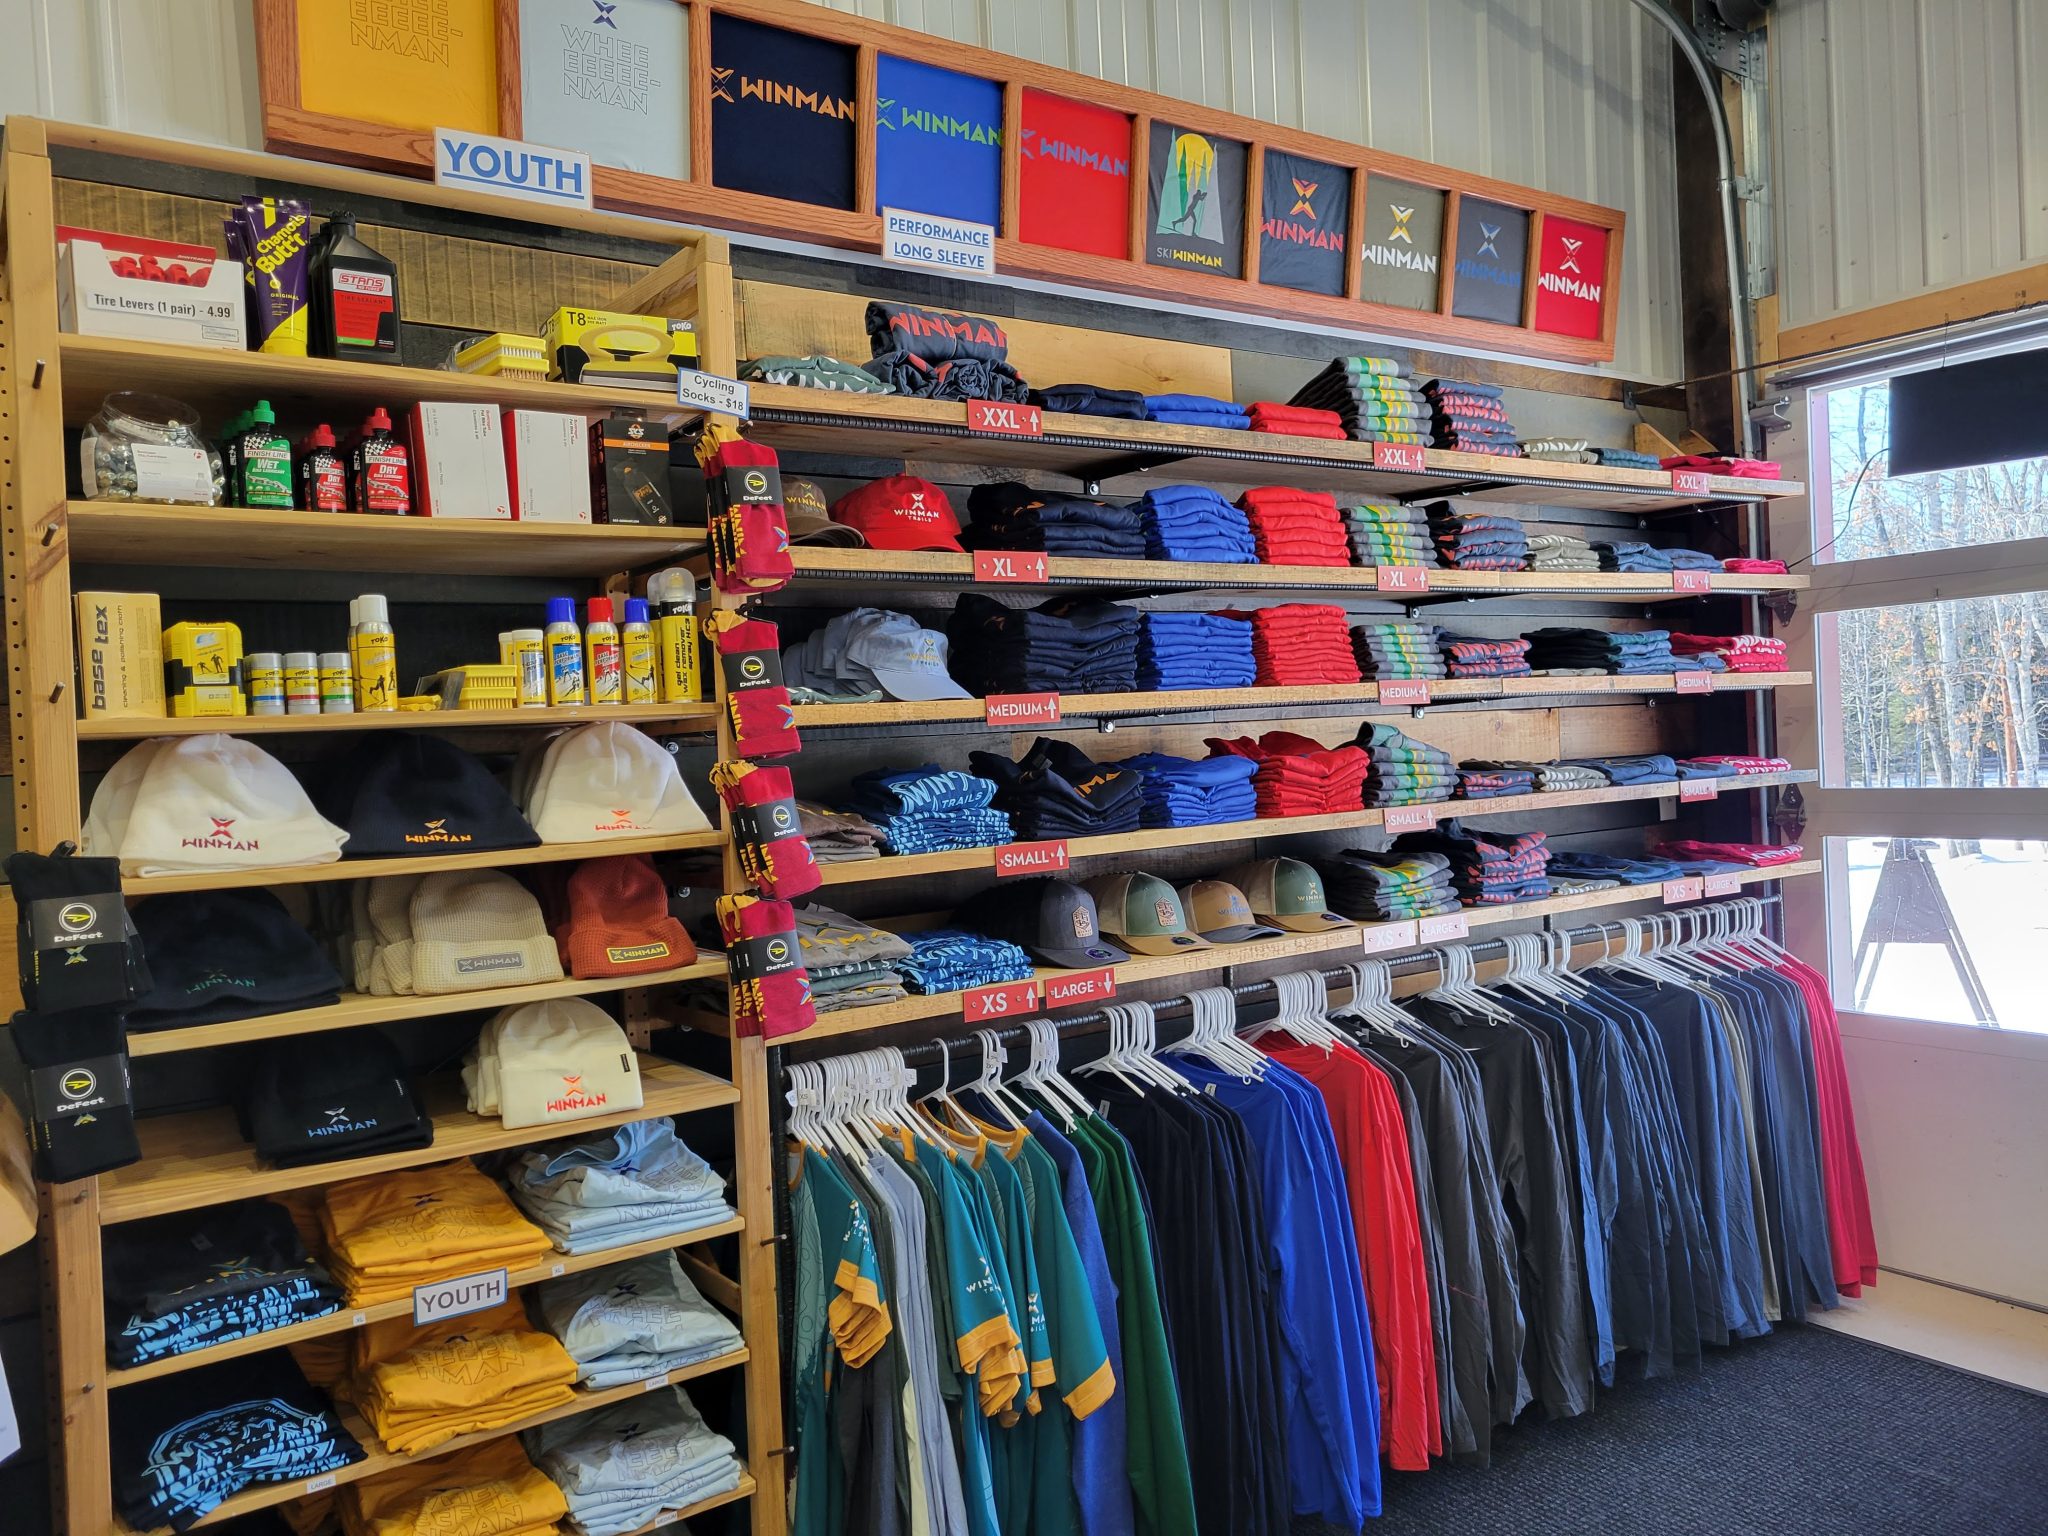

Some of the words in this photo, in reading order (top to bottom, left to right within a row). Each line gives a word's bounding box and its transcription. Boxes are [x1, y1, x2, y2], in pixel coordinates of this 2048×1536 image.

[350, 21, 449, 68] NMAN
[560, 24, 649, 68] WHEE
[563, 72, 648, 114] NMAN
[741, 76, 855, 124] WINMAN
[902, 106, 1002, 148] WINMAN
[1039, 138, 1128, 177] WINMAN
[441, 138, 582, 194] YOUTH
[256, 214, 306, 254] Chamois
[889, 217, 989, 246] PERFORMANCE
[1260, 216, 1344, 252] WINMAN
[894, 241, 934, 260] LONG
[937, 247, 986, 268] SLEEVE
[1362, 244, 1437, 274] WINMAN
[1538, 272, 1600, 302] WINMAN
[270, 292, 300, 300] ORIGINAL
[94, 294, 116, 306] Tire
[120, 296, 154, 312] Levers
[158, 300, 167, 314] (1
[170, 303, 196, 317] pair)
[207, 306, 230, 318] 4.99
[566, 311, 586, 326] T8
[671, 321, 692, 331] TOKO
[694, 375, 735, 394] Cycling
[682, 388, 716, 404] Socks
[726, 398, 744, 411] $18
[983, 407, 1020, 429] XXL
[256, 460, 279, 469] WET
[1384, 451, 1409, 467] XXL
[379, 465, 398, 474] DRY
[1680, 475, 1698, 489] XXL
[786, 497, 826, 510] WINMAN
[894, 509, 939, 518] WINMAN
[992, 558, 1017, 577] XL
[1390, 572, 1407, 587] XL
[1683, 576, 1695, 588] XL
[672, 604, 692, 614] TOKO
[95, 604, 108, 644] tex
[371, 636, 388, 644] TOKO
[92, 649, 106, 711] base
[740, 678, 771, 687] DeFeet
[1384, 687, 1416, 698] MEDIUM
[990, 703, 1042, 717] MEDIUM
[942, 792, 983, 808] TRAILS
[1390, 814, 1422, 826] SMALL
[405, 834, 472, 843] WINMAN
[774, 828, 797, 837] DeFeet
[182, 838, 259, 851] WINMAN
[1004, 851, 1049, 868] SMALL
[1672, 885, 1686, 898] XS
[1708, 881, 1729, 890] LARGE
[1426, 922, 1453, 936] LARGE
[54, 932, 103, 943] DeFeet
[1376, 930, 1393, 947] XS
[623, 945, 664, 958] WINMAN
[470, 954, 521, 969] WINMAN
[766, 961, 794, 971] DeFeet
[1054, 982, 1094, 998] LARGE
[982, 993, 1007, 1013] XS
[57, 1097, 105, 1112] DeFeet
[546, 1094, 606, 1113] WINMAN
[308, 1118, 378, 1138] WINMAN
[966, 1277, 992, 1293] WIN
[421, 1280, 500, 1312] YOUTH
[310, 1480, 333, 1490] LARGE
